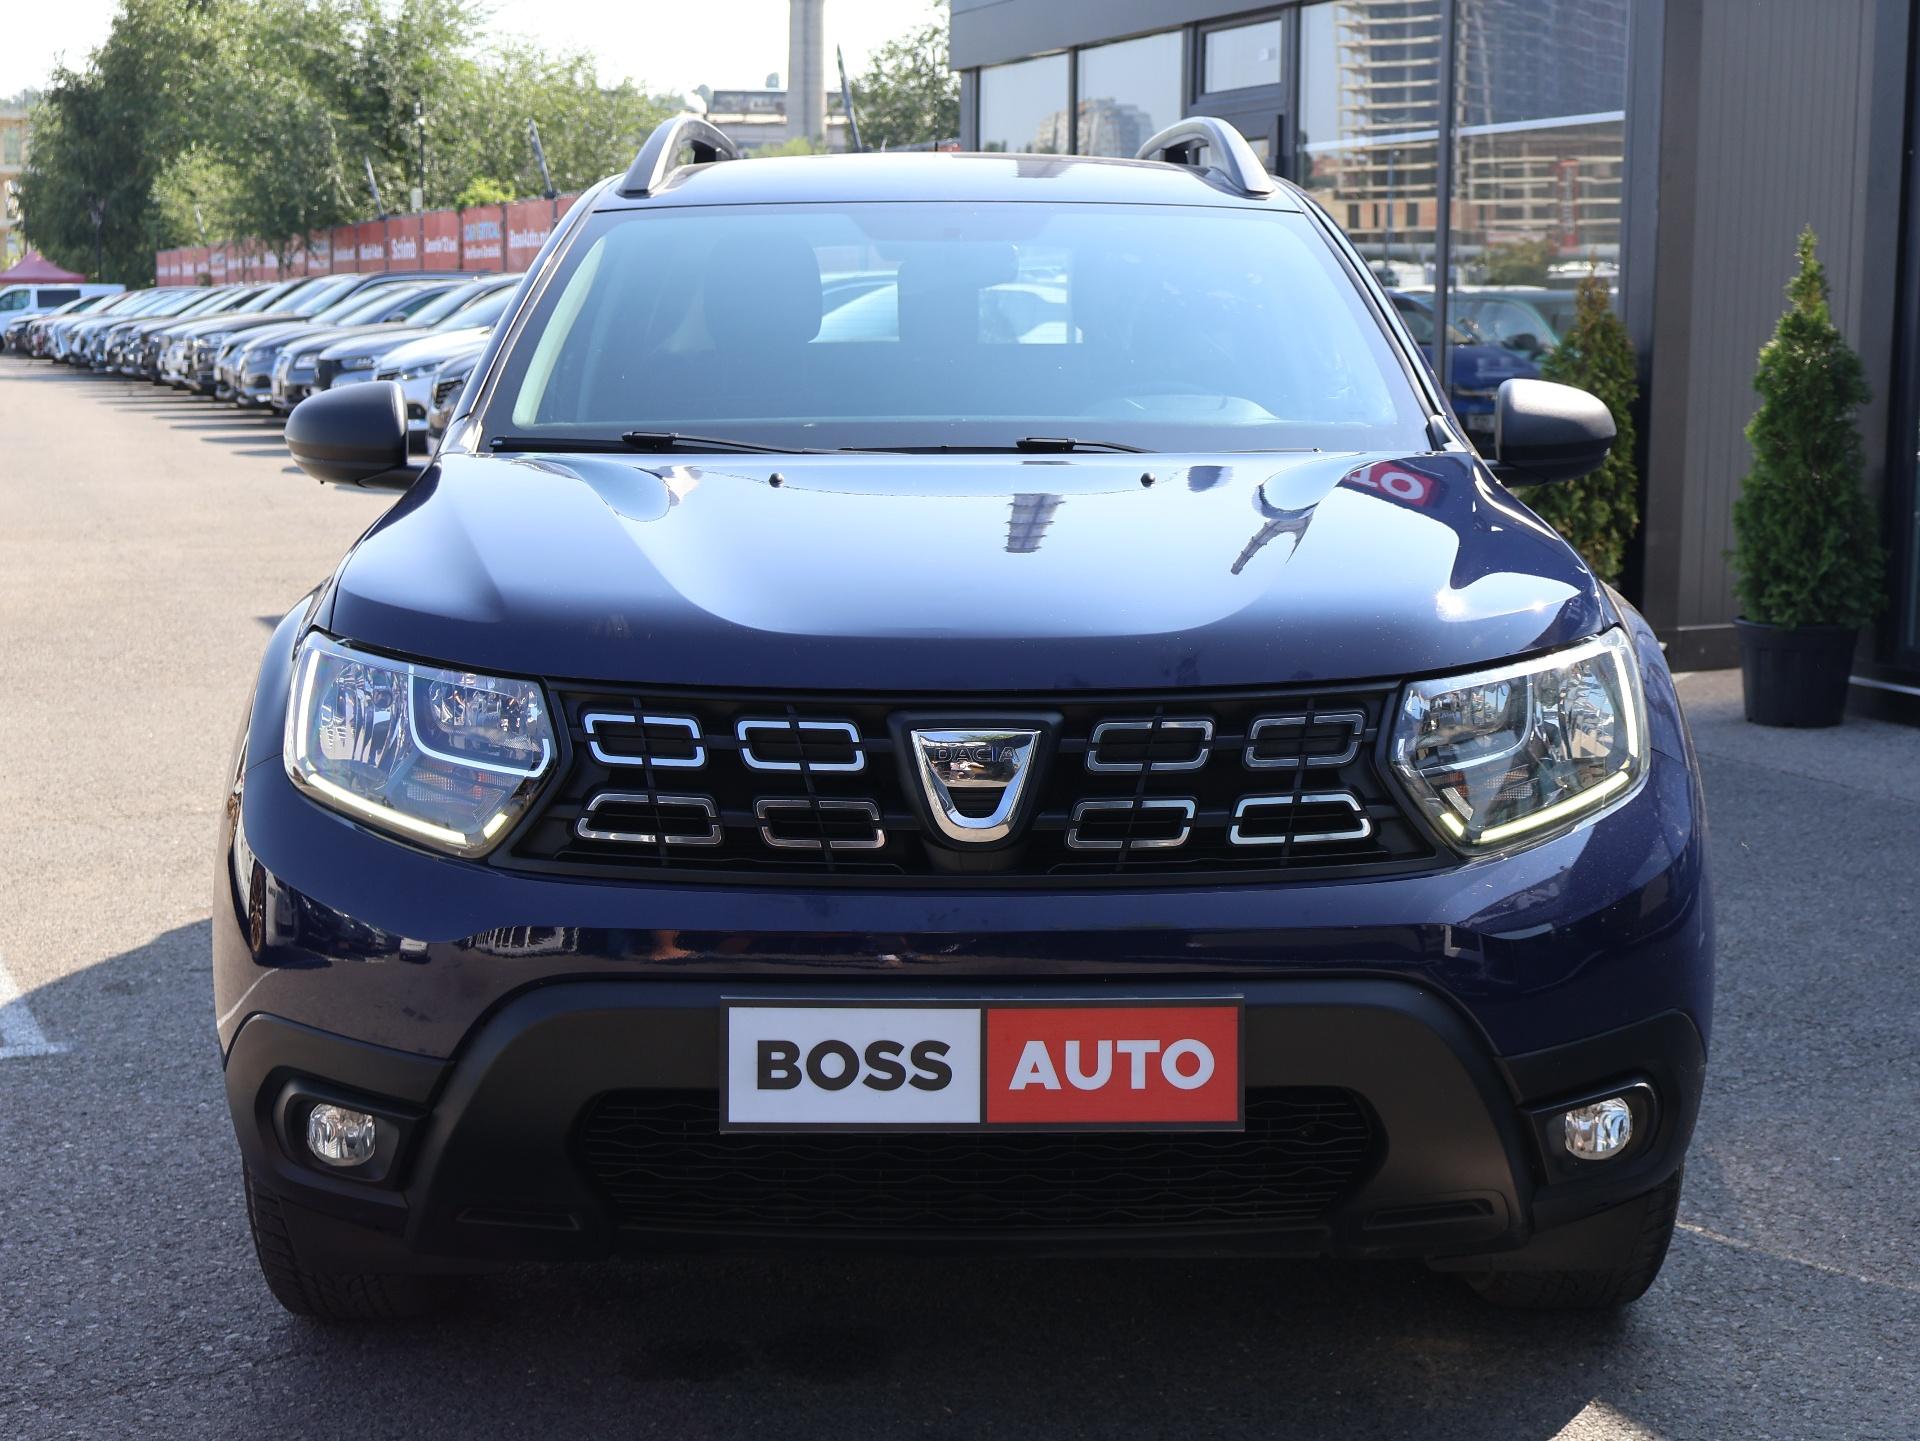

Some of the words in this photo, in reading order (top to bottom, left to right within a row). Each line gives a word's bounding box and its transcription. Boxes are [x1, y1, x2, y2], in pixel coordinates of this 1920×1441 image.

[934, 746, 1019, 763] DACIA
[757, 1039, 953, 1091] BOSS
[1008, 1038, 1215, 1091] AUTO
